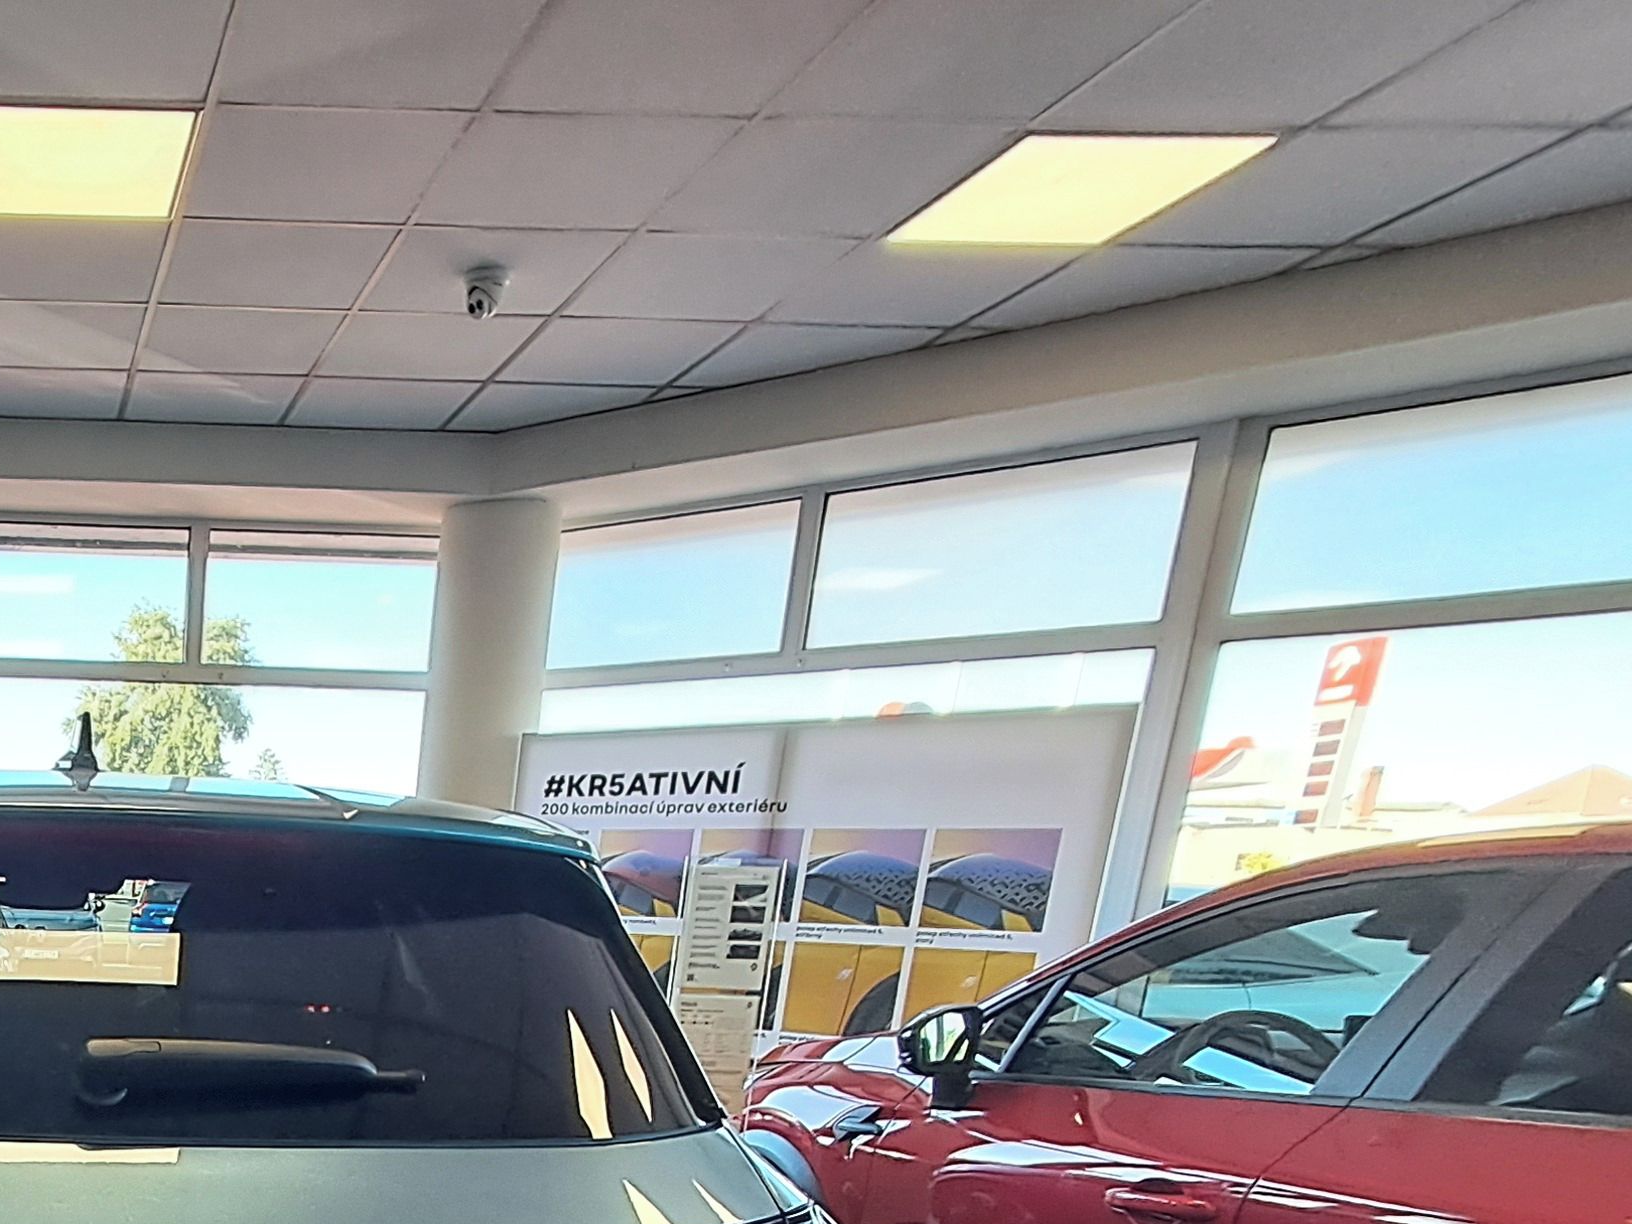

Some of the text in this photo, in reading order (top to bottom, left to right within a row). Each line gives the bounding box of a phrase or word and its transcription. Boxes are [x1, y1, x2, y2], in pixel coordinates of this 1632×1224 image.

[543, 761, 747, 798] #KR5ATIVNÍ
[541, 798, 788, 817] 200 kombinací úprav exteriéru
